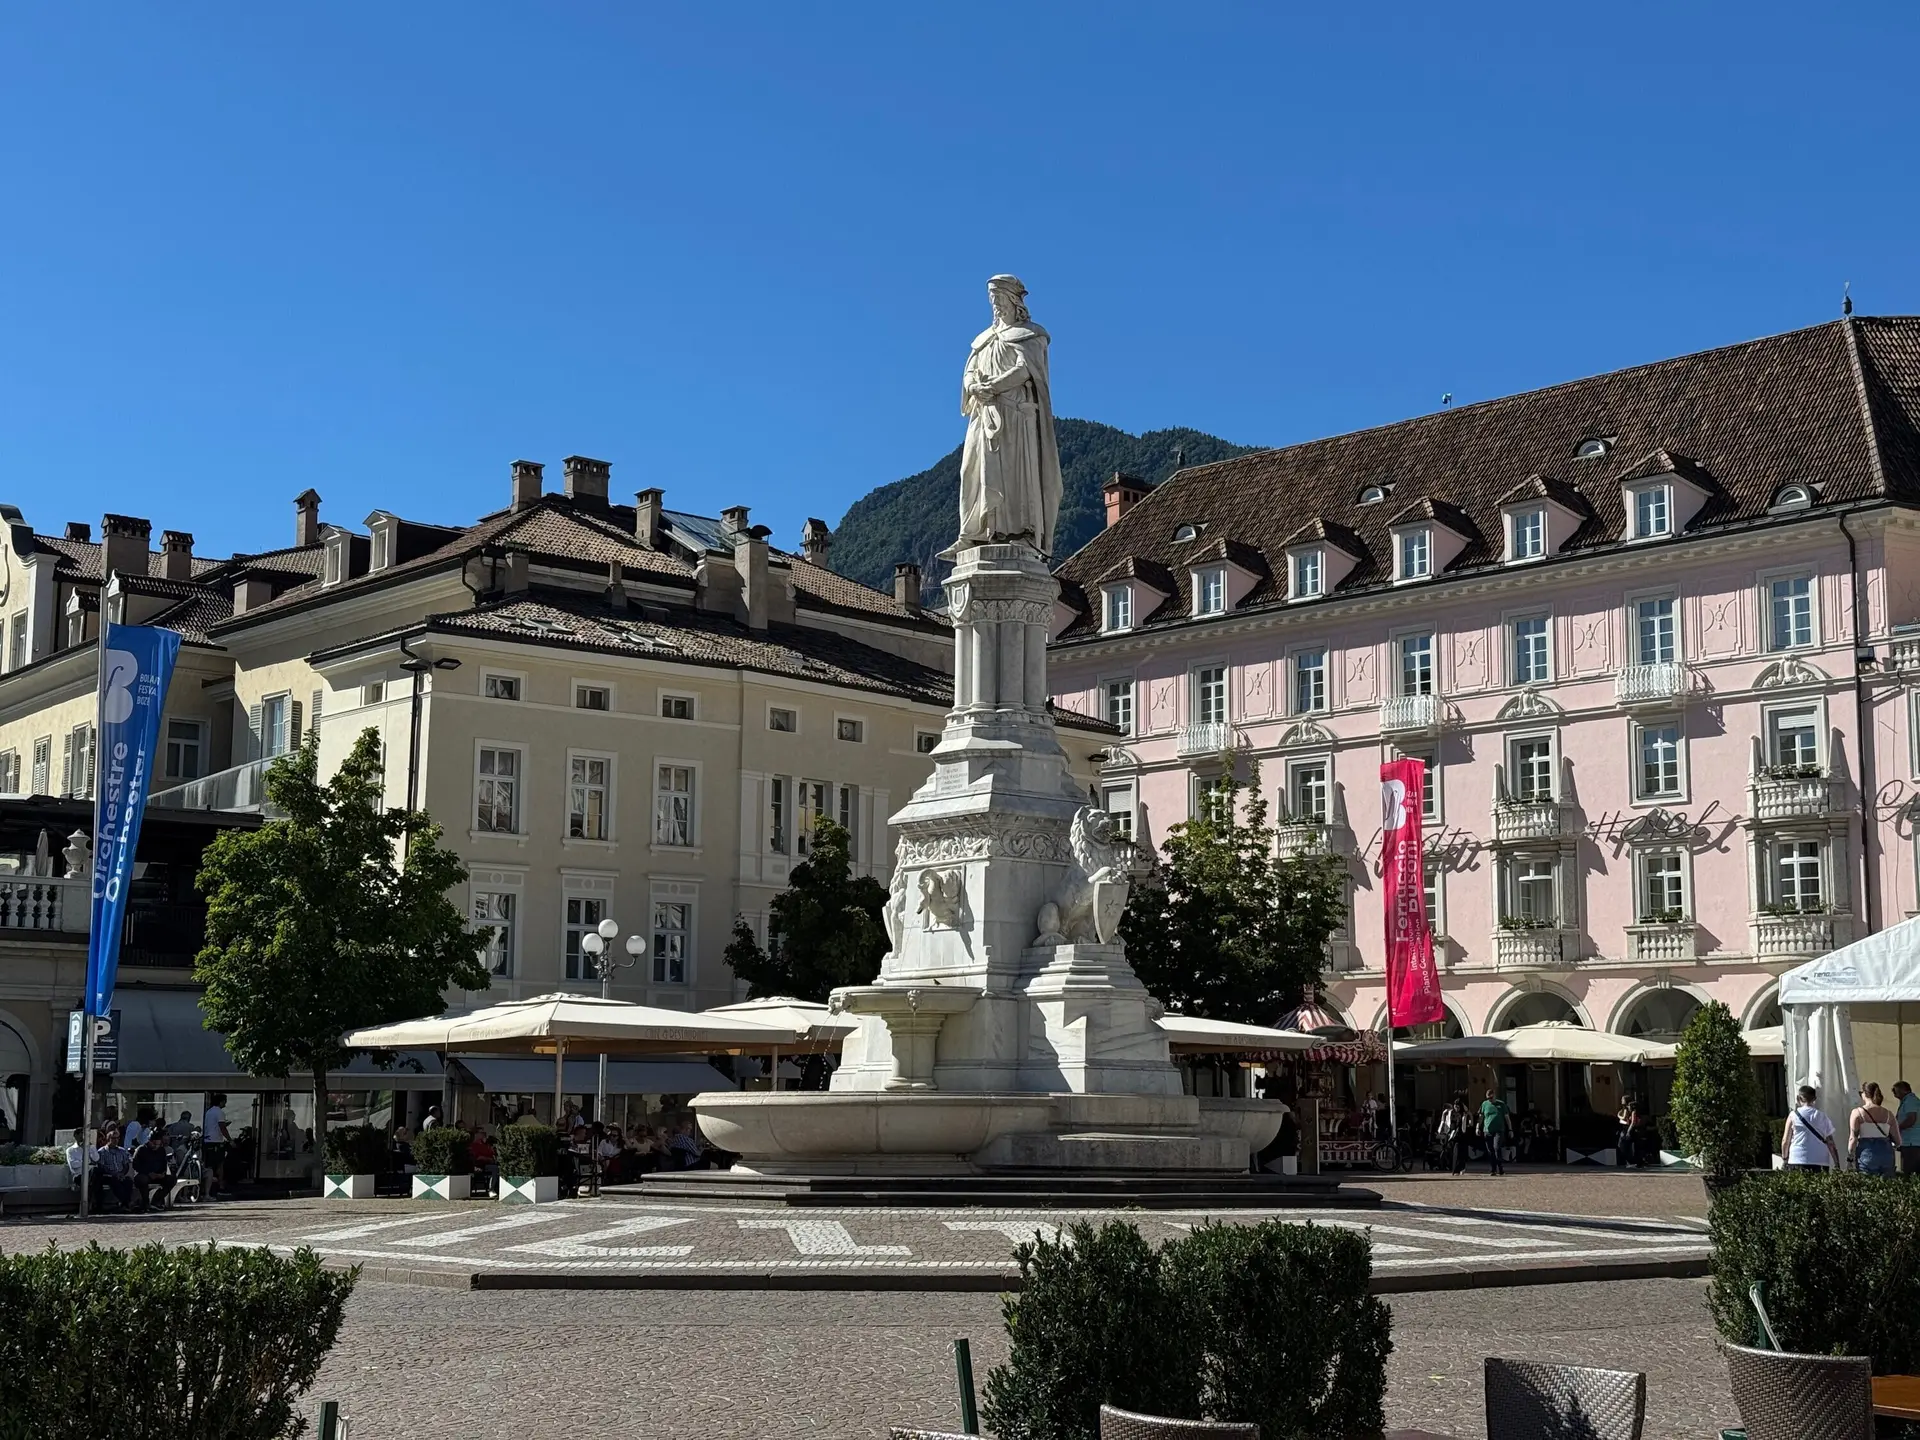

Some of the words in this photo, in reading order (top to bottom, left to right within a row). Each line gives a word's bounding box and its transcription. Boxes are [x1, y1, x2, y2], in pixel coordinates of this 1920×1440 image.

[93, 741, 128, 899] Orchestre
[1589, 800, 1720, 843] Hotel
[1395, 840, 1409, 942] Ferruccio
[1422, 971, 1431, 995] Piano
[94, 1020, 111, 1044] P
